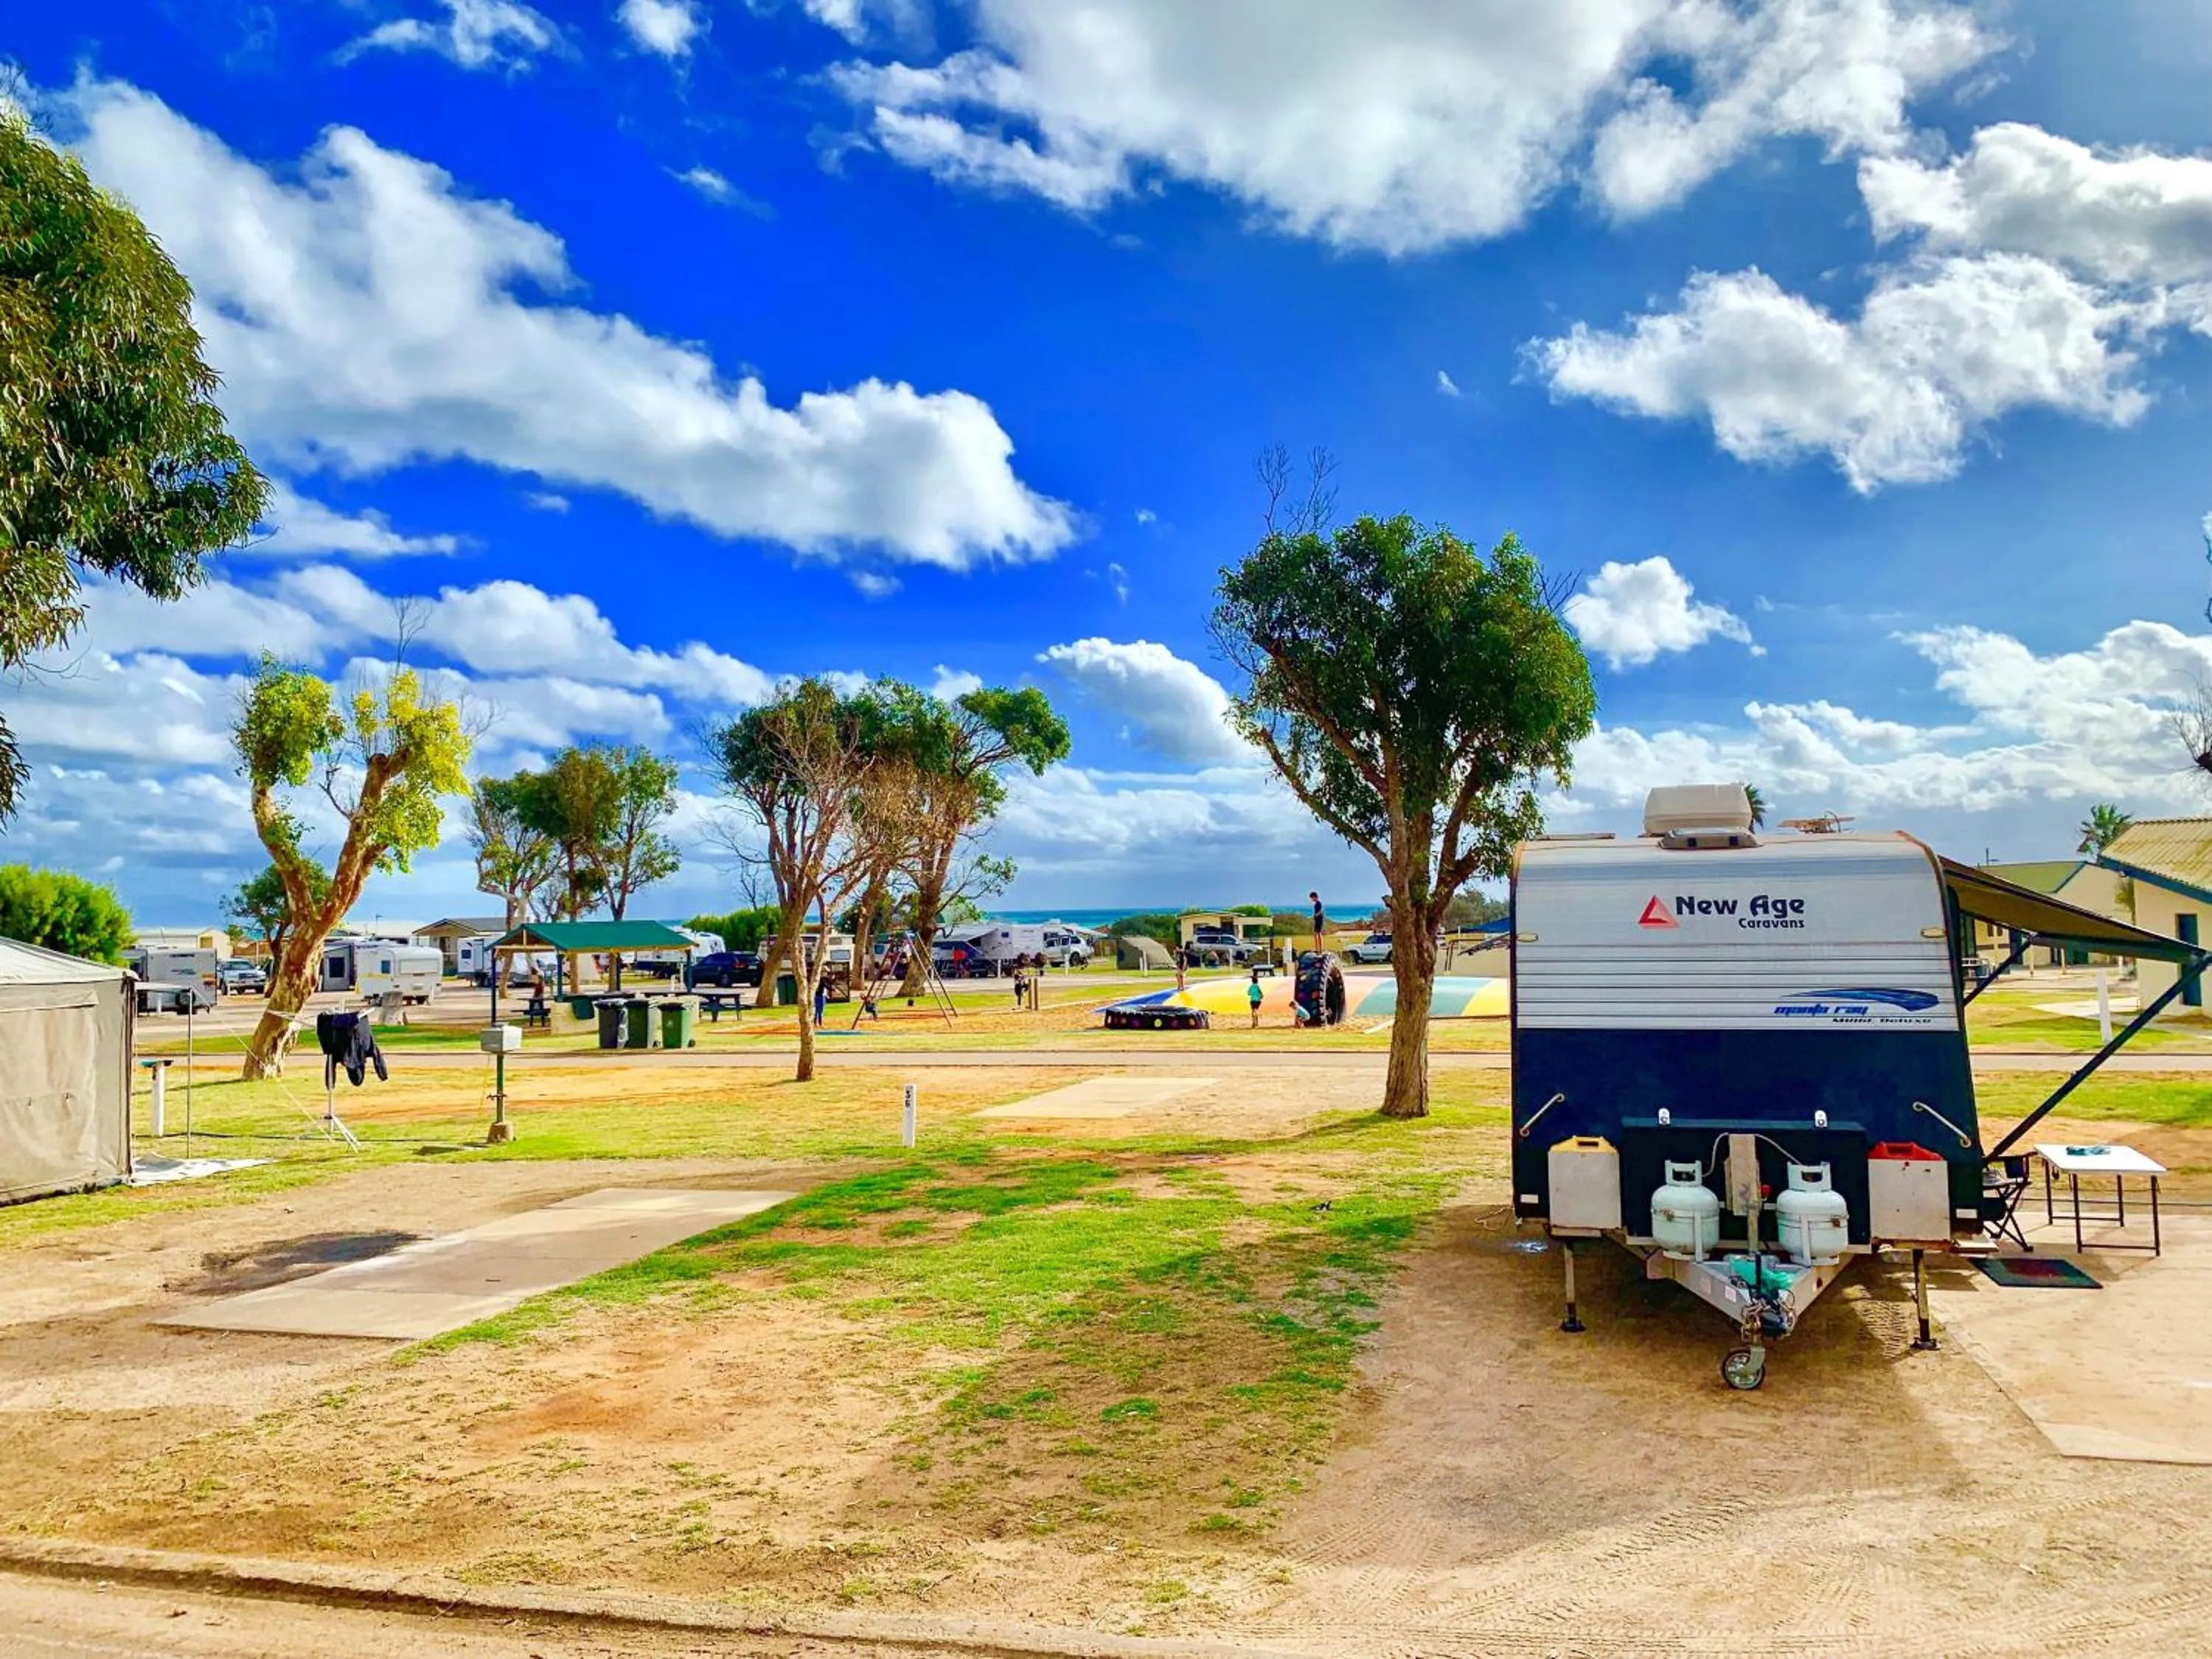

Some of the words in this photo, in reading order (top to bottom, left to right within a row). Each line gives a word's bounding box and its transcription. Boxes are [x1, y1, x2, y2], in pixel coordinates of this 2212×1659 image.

[1675, 896, 1738, 915] New
[1750, 894, 1805, 919] Age
[1738, 918, 1805, 928] Caravans
